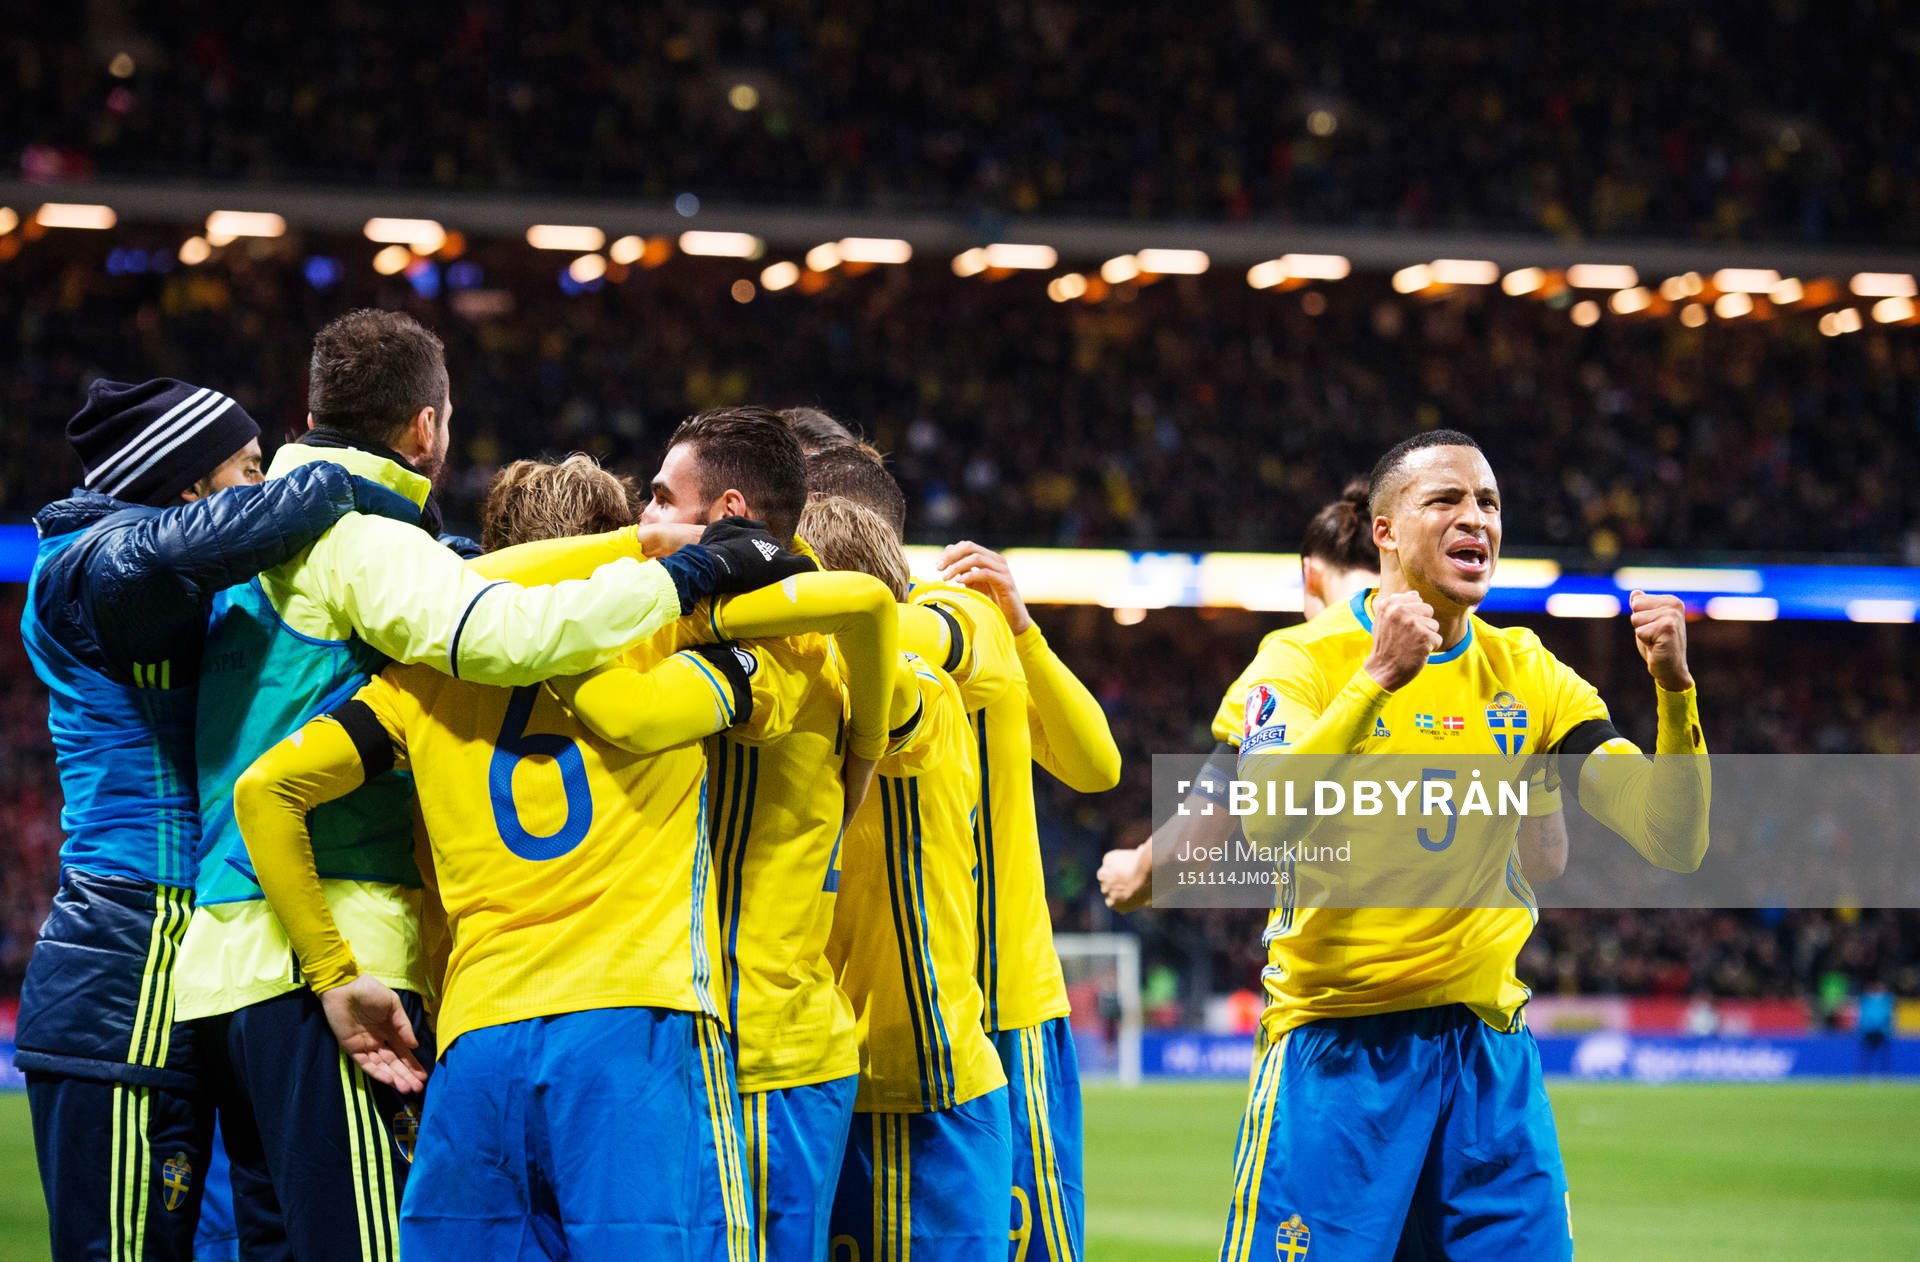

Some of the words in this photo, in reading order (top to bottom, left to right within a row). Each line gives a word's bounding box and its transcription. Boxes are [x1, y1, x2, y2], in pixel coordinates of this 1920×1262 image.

[489, 682, 593, 861] 6
[1241, 729, 1285, 754] RESPECT
[1417, 768, 1457, 852] 5
